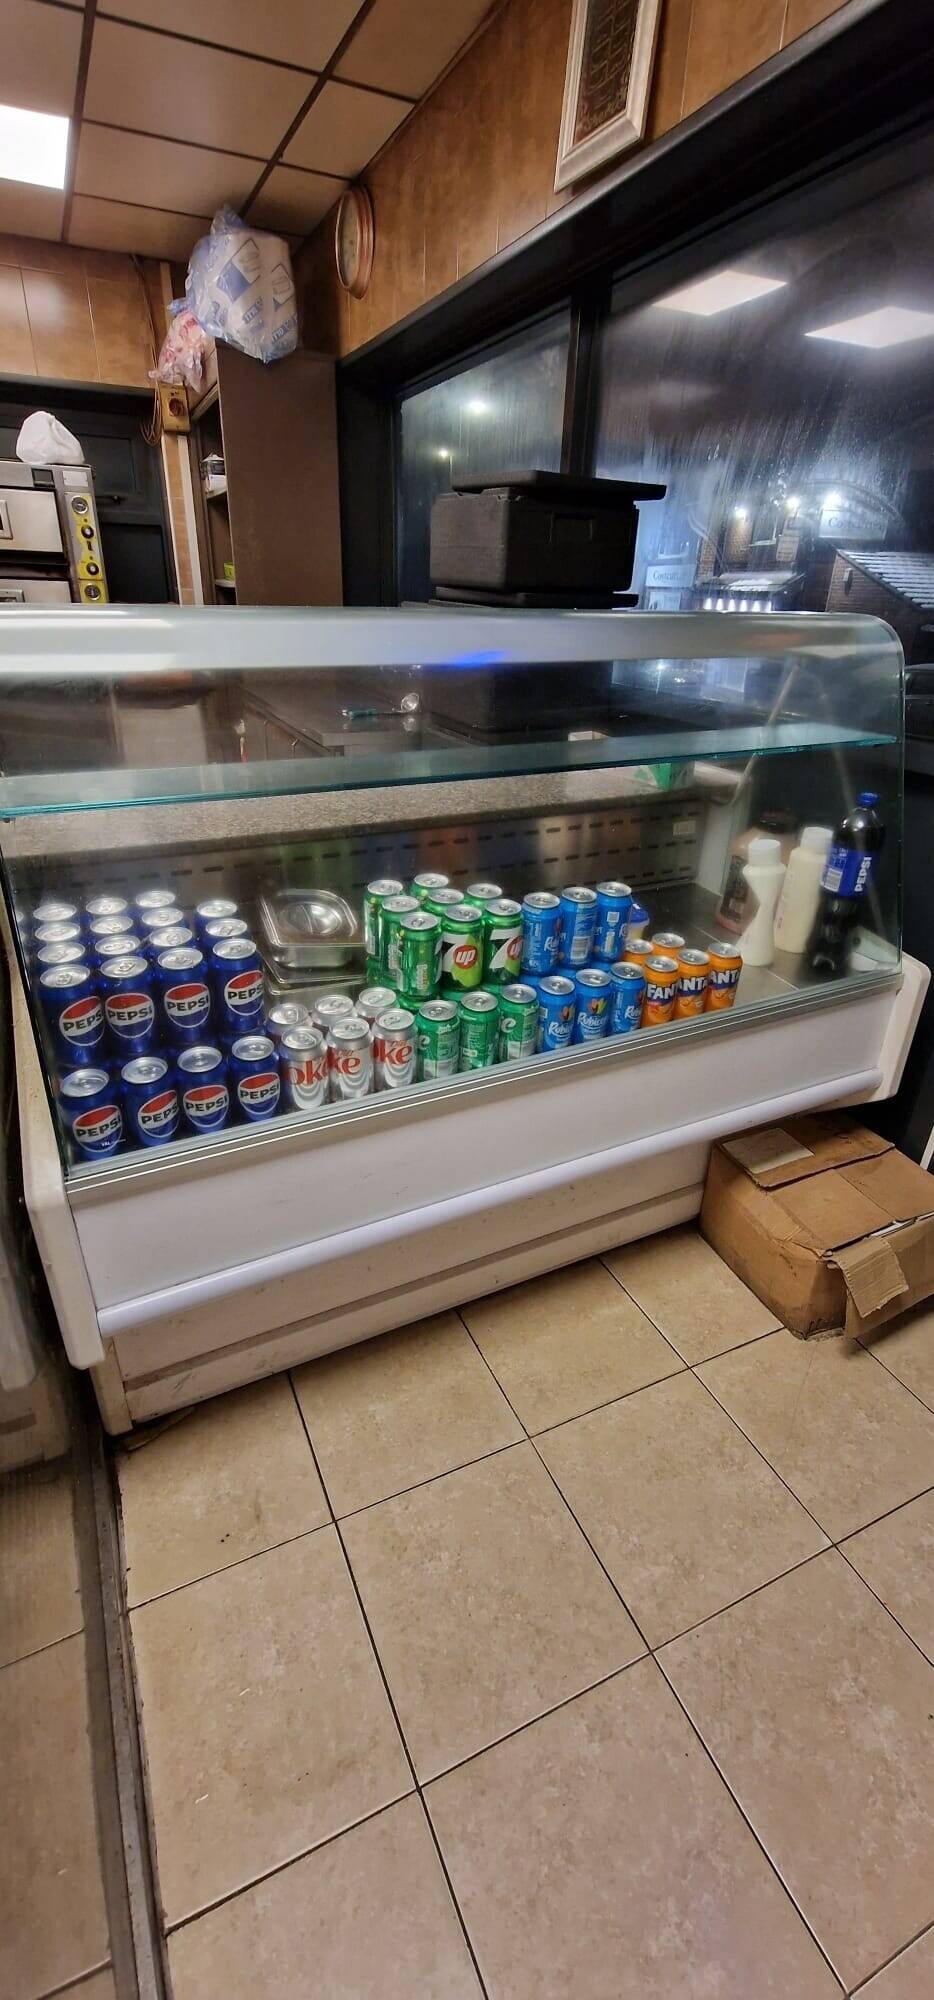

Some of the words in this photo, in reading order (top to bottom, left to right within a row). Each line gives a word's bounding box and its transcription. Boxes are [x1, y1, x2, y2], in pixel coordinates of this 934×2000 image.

[854, 857, 872, 892] PEPSI
[647, 983, 675, 1000] FAN
[63, 1009, 103, 1032] PEPS
[240, 1083, 280, 1100] PEPSI
[185, 1095, 227, 1112] PEPSI
[141, 1103, 179, 1125] PEPS
